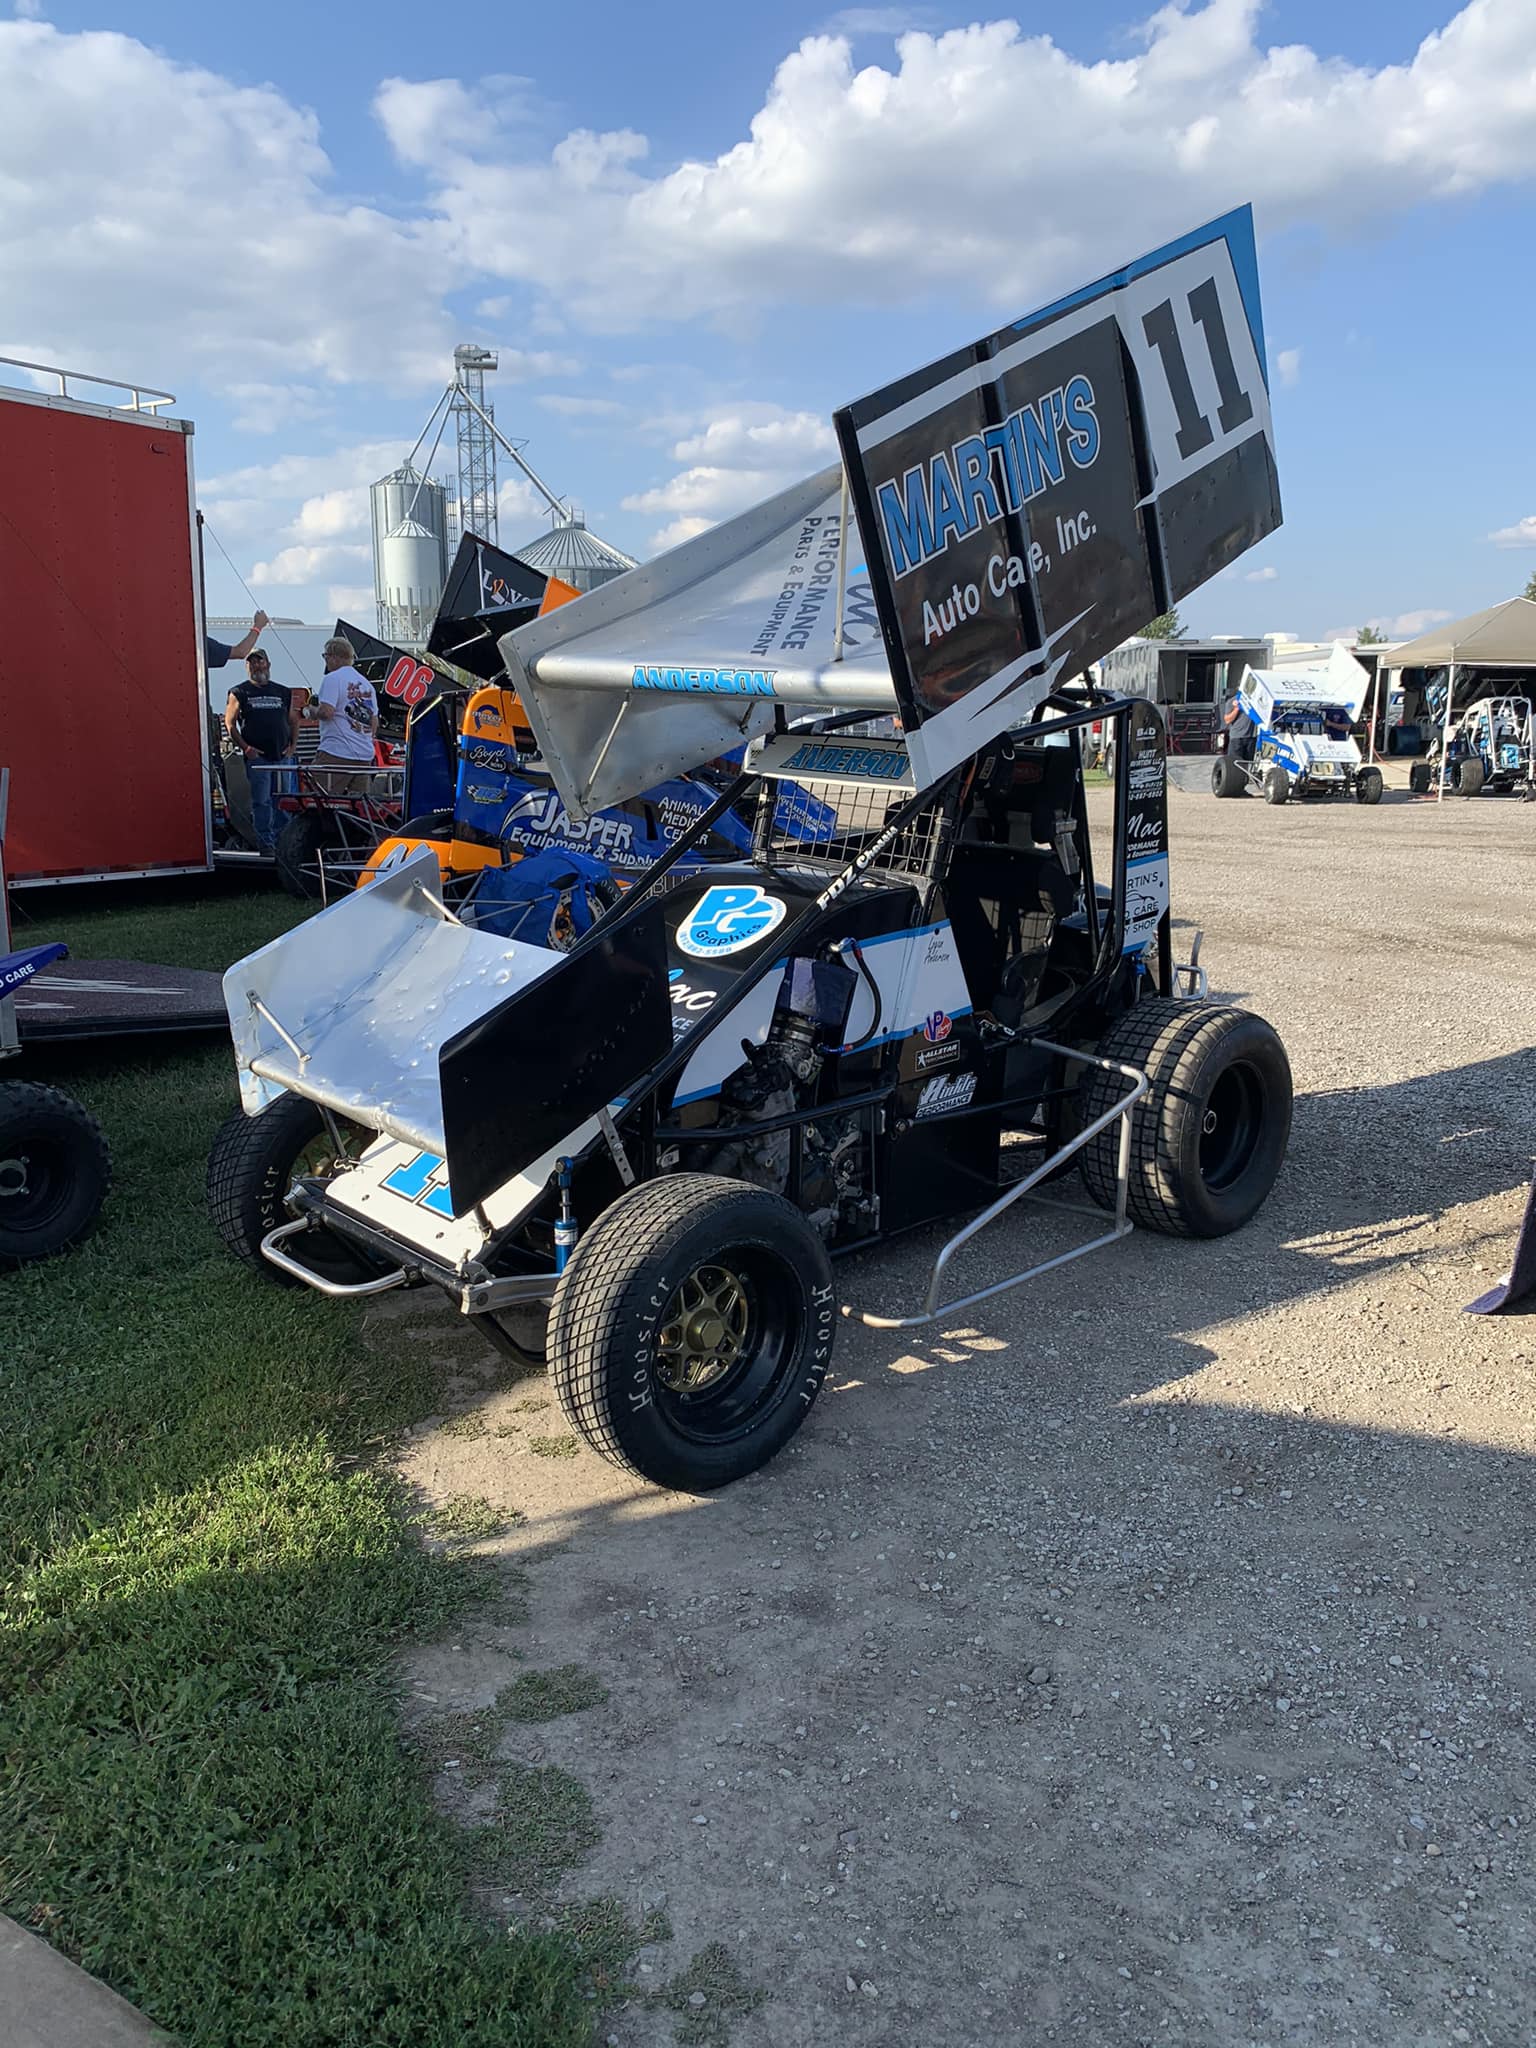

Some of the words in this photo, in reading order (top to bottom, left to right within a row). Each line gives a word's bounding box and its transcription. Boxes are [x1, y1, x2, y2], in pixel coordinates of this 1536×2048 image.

[1142, 276, 1254, 460] 11
[875, 374, 1101, 582] MARTIN'S
[795, 517, 822, 559] PARTS
[922, 581, 981, 646] Auto
[1056, 508, 1098, 555] Inc.
[750, 581, 803, 656] EQUIPMENT
[385, 655, 435, 706] 06
[631, 665, 778, 696] ANDERSON
[469, 745, 506, 769] Boyd
[784, 744, 910, 780] ANDERSON
[531, 796, 633, 850] JASPER
[658, 796, 703, 817] ANIMAL
[510, 827, 593, 855] Equipment
[592, 845, 605, 860] &
[1127, 871, 1159, 890] RTIN'S
[1133, 901, 1160, 916] CARE
[696, 924, 762, 946] Graphics
[1133, 919, 1156, 933] SHOP
[5, 963, 36, 985] CARE
[926, 1010, 944, 1041] VP
[628, 1276, 670, 1413] Hoosier
